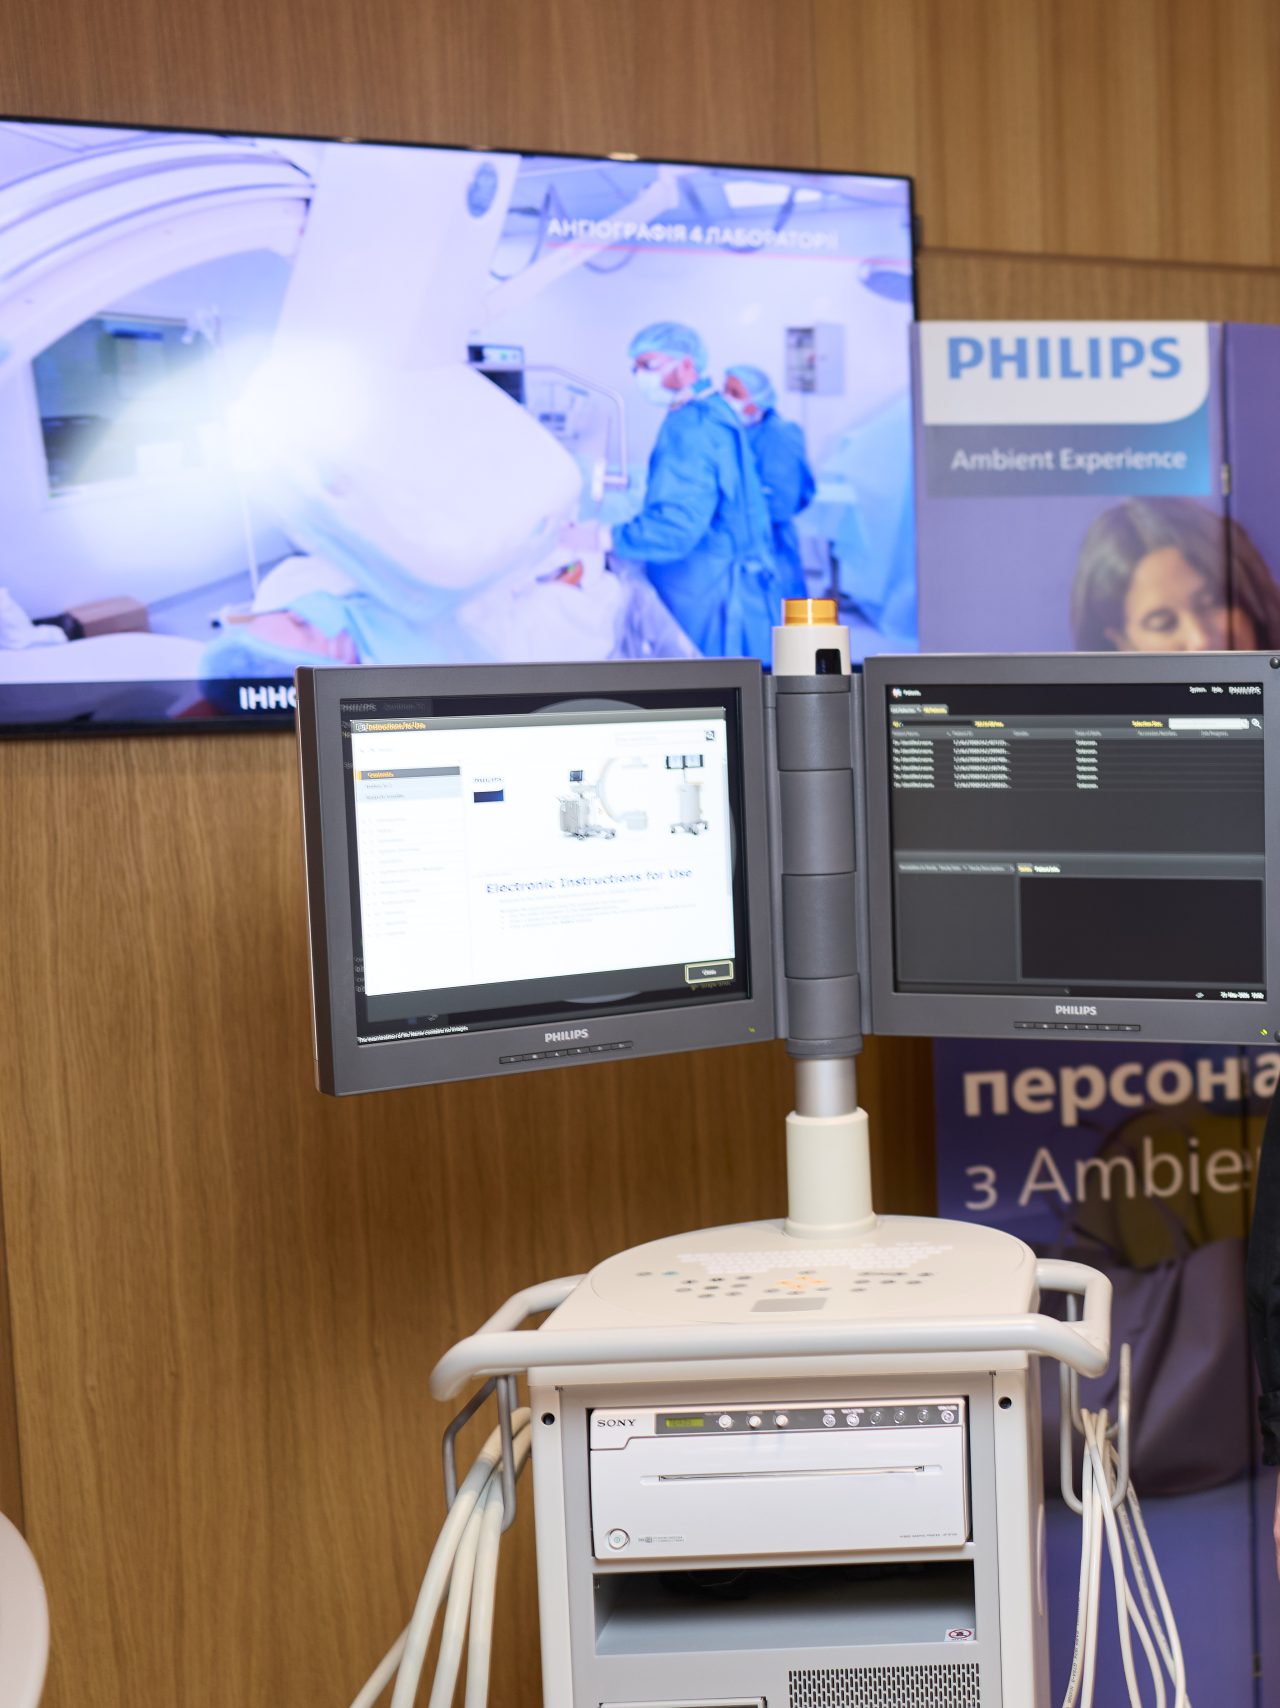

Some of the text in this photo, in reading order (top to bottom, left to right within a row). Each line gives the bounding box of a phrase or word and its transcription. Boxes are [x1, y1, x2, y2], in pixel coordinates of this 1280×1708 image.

[946, 336, 1182, 380] PHILIPS
[951, 447, 1188, 474] Ambient Experience
[486, 868, 693, 895] Electronic Instructions for Use
[1055, 1004, 1097, 1016] PHILIPS
[544, 1028, 589, 1043] PHILIPS
[1017, 1136, 1254, 1207] Ambie
[597, 1418, 636, 1428] SONY
